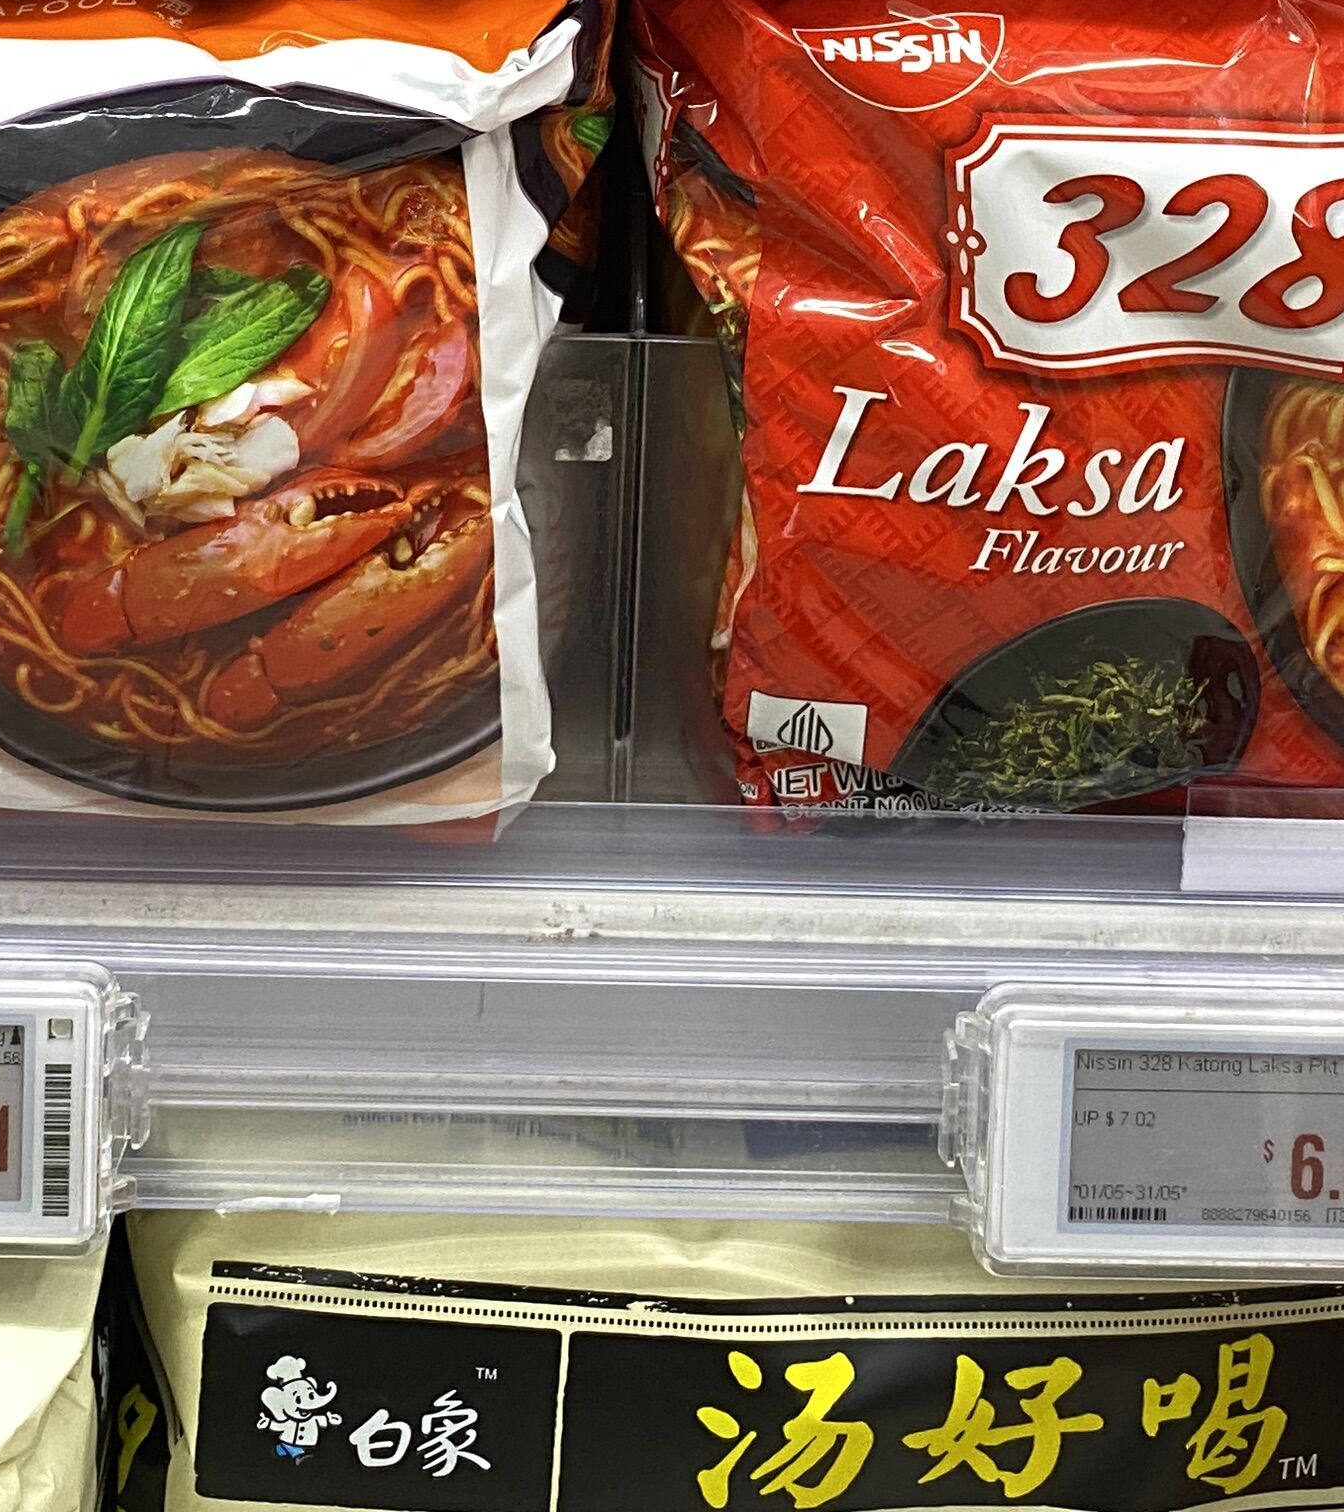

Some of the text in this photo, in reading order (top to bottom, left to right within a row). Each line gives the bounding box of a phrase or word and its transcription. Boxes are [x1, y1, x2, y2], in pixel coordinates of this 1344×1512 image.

[822, 29, 984, 73] NISSIN
[796, 385, 1186, 517] Laksa
[968, 528, 1185, 575] Flavour
[1076, 1054, 1133, 1071] Nissin
[1138, 1054, 1172, 1071] 328
[1177, 1055, 1243, 1076] Katong
[1248, 1056, 1303, 1074] Laksa
[1309, 1057, 1339, 1075] Pkt
[1074, 1110, 1100, 1126] UP
[474, 1367, 498, 1380] TM
[349, 1389, 492, 1478] 白象
[696, 1332, 1288, 1509] 汤好喝
[1279, 1456, 1319, 1480] TM
